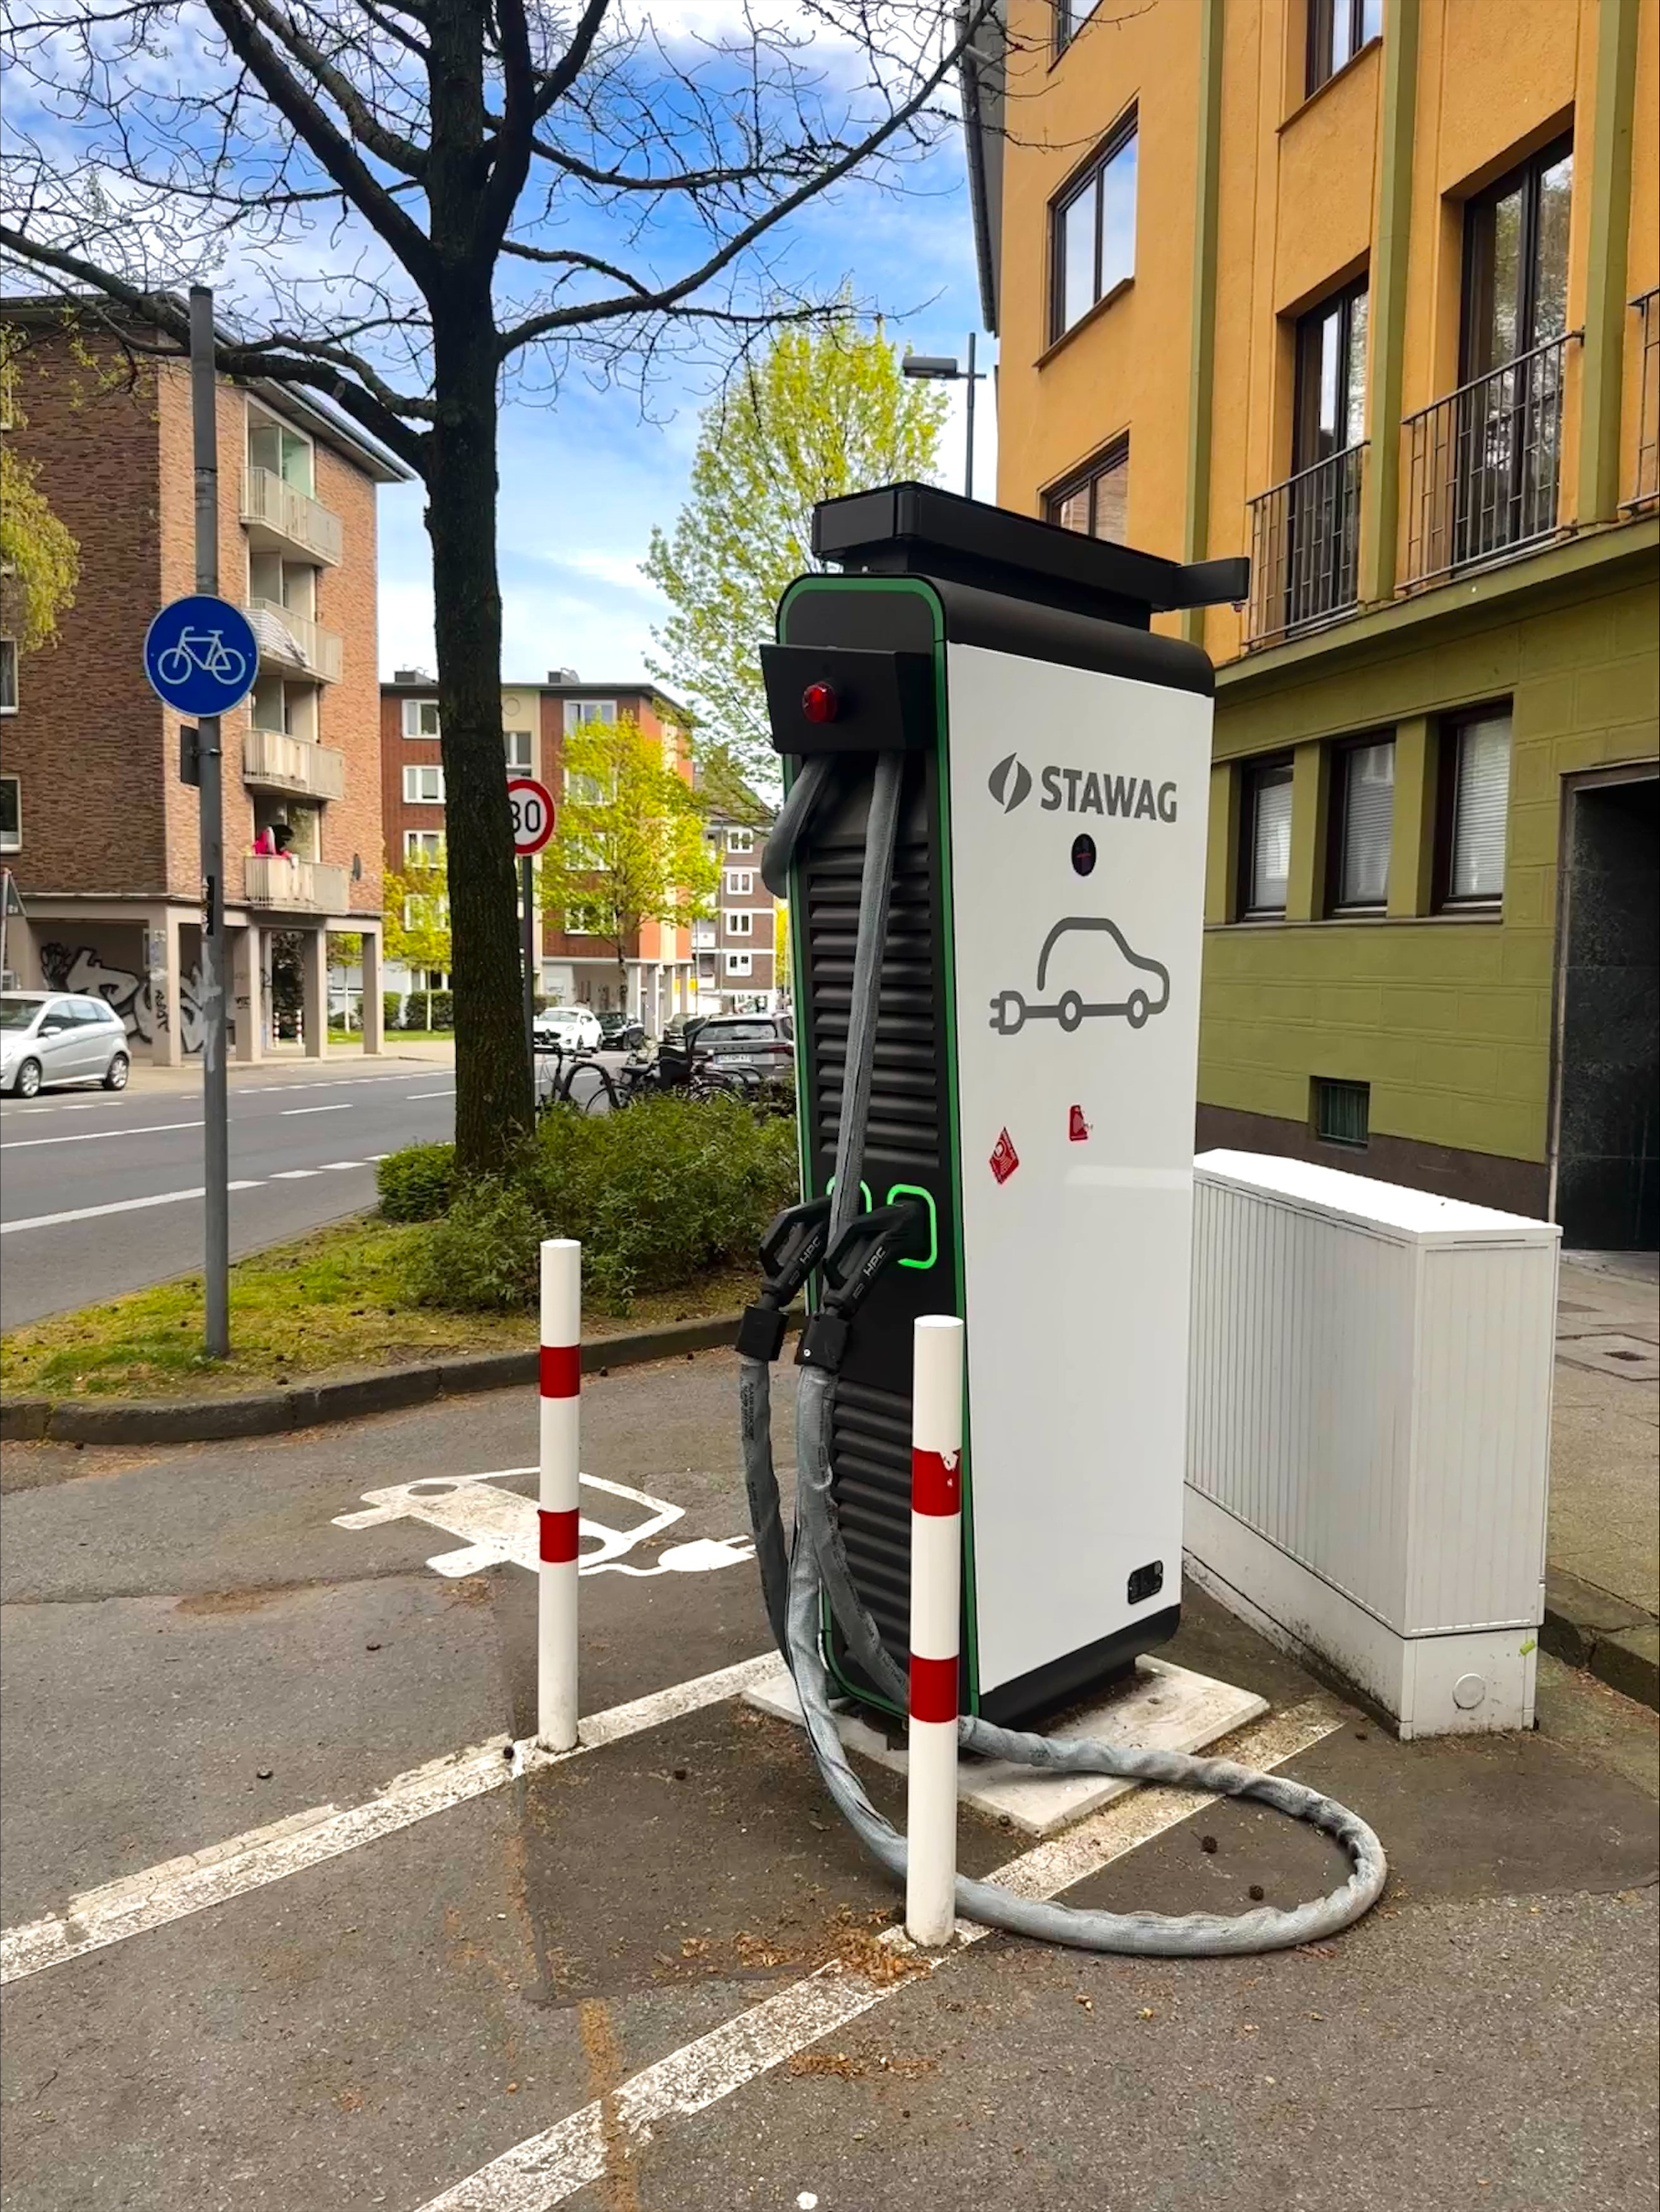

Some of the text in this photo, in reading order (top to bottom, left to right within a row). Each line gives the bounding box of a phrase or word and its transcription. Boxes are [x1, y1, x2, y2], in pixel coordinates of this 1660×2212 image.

[1040, 765, 1177, 824] STAWAG
[799, 1235, 821, 1264] HPC
[862, 1245, 887, 1277] HPC
